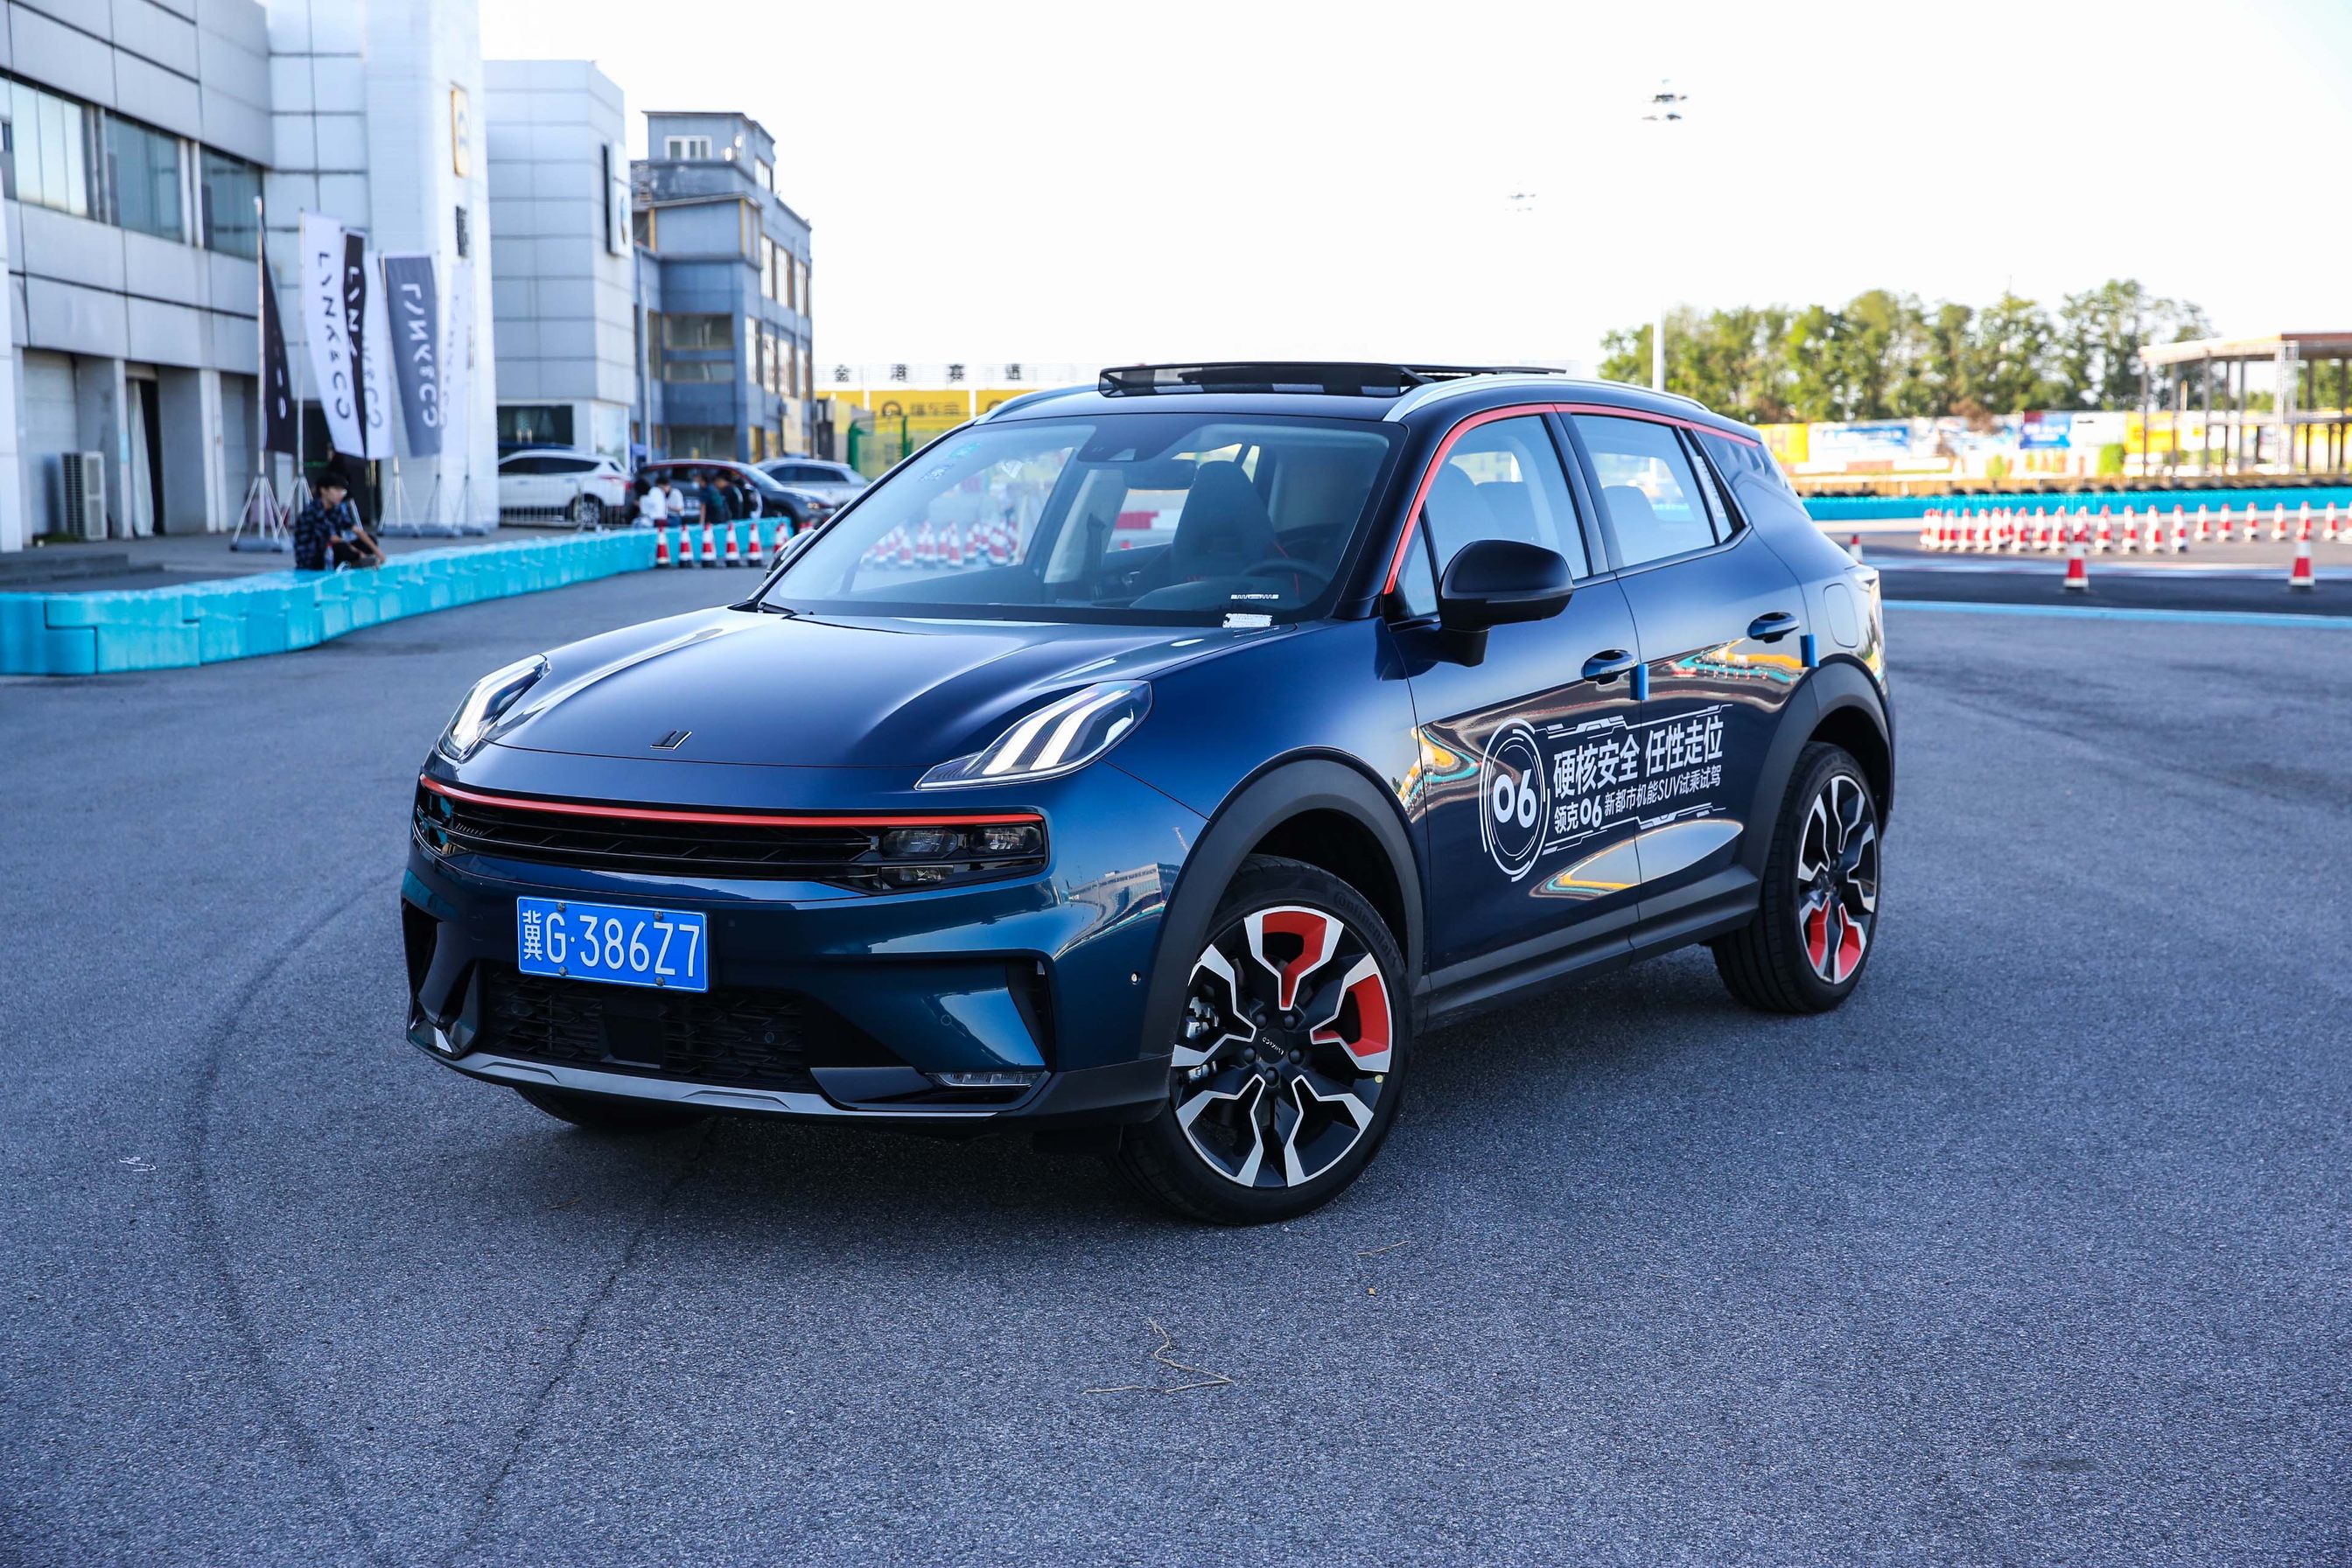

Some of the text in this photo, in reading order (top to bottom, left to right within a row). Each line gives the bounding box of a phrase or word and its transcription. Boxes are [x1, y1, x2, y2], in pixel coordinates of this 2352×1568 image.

[1552, 716, 1725, 800] 硬核安全 任性走位
[1492, 767, 1538, 830] 06
